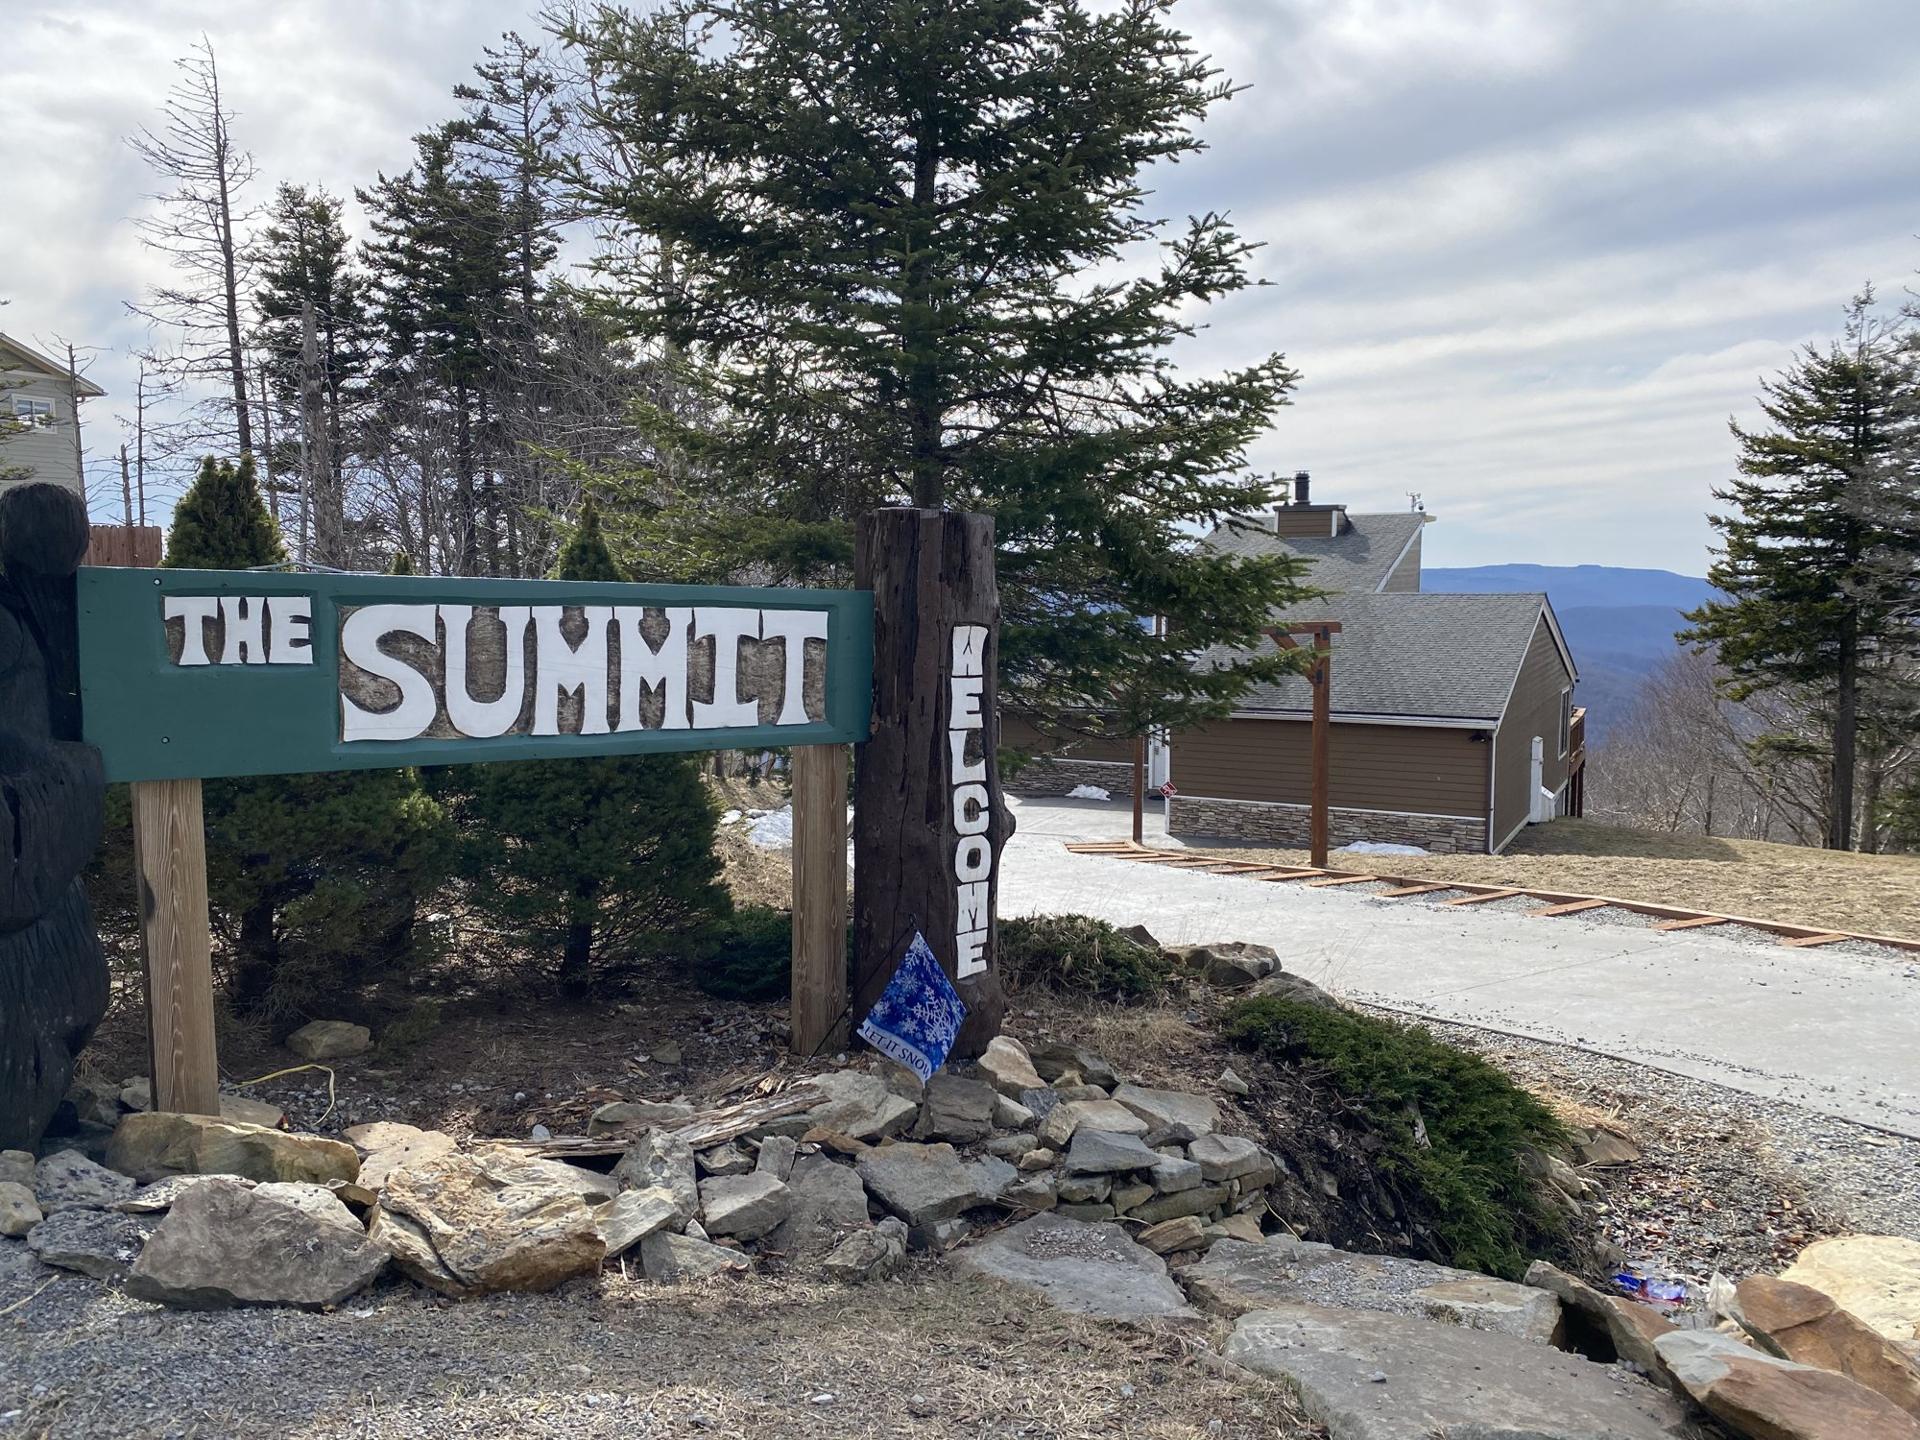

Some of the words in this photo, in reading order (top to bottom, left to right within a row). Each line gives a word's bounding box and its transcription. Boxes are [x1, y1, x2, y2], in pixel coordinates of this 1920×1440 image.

[164, 596, 314, 665] THE
[341, 604, 829, 741] SUMMIT
[948, 625, 992, 980] WELCOME
[865, 1026, 885, 1045] LET
[885, 1039, 899, 1052] IT
